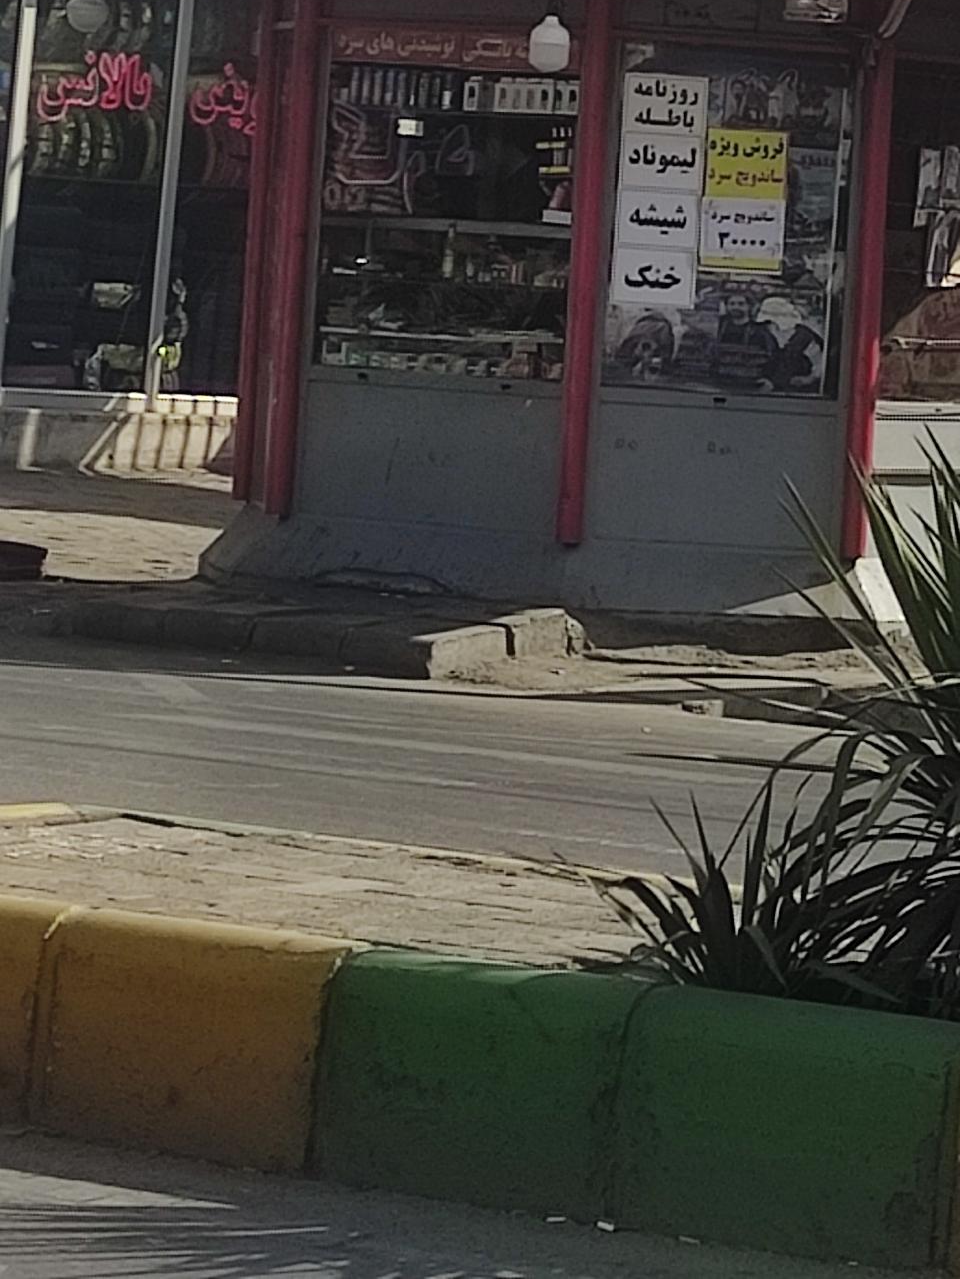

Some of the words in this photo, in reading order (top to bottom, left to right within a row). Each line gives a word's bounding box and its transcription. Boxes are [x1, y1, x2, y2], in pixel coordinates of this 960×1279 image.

[366, 32, 395, 56] های
[397, 35, 456, 59] نوشیدنی
[633, 78, 699, 106] روزنامه
[634, 107, 695, 133] باطله
[628, 144, 698, 174] لیموناد
[709, 136, 739, 158] ویژه
[742, 137, 785, 160] فروش
[708, 167, 733, 185] سرد
[735, 168, 784, 187] ساندویچ
[629, 203, 688, 235] شیشه
[623, 265, 682, 290] خنک
